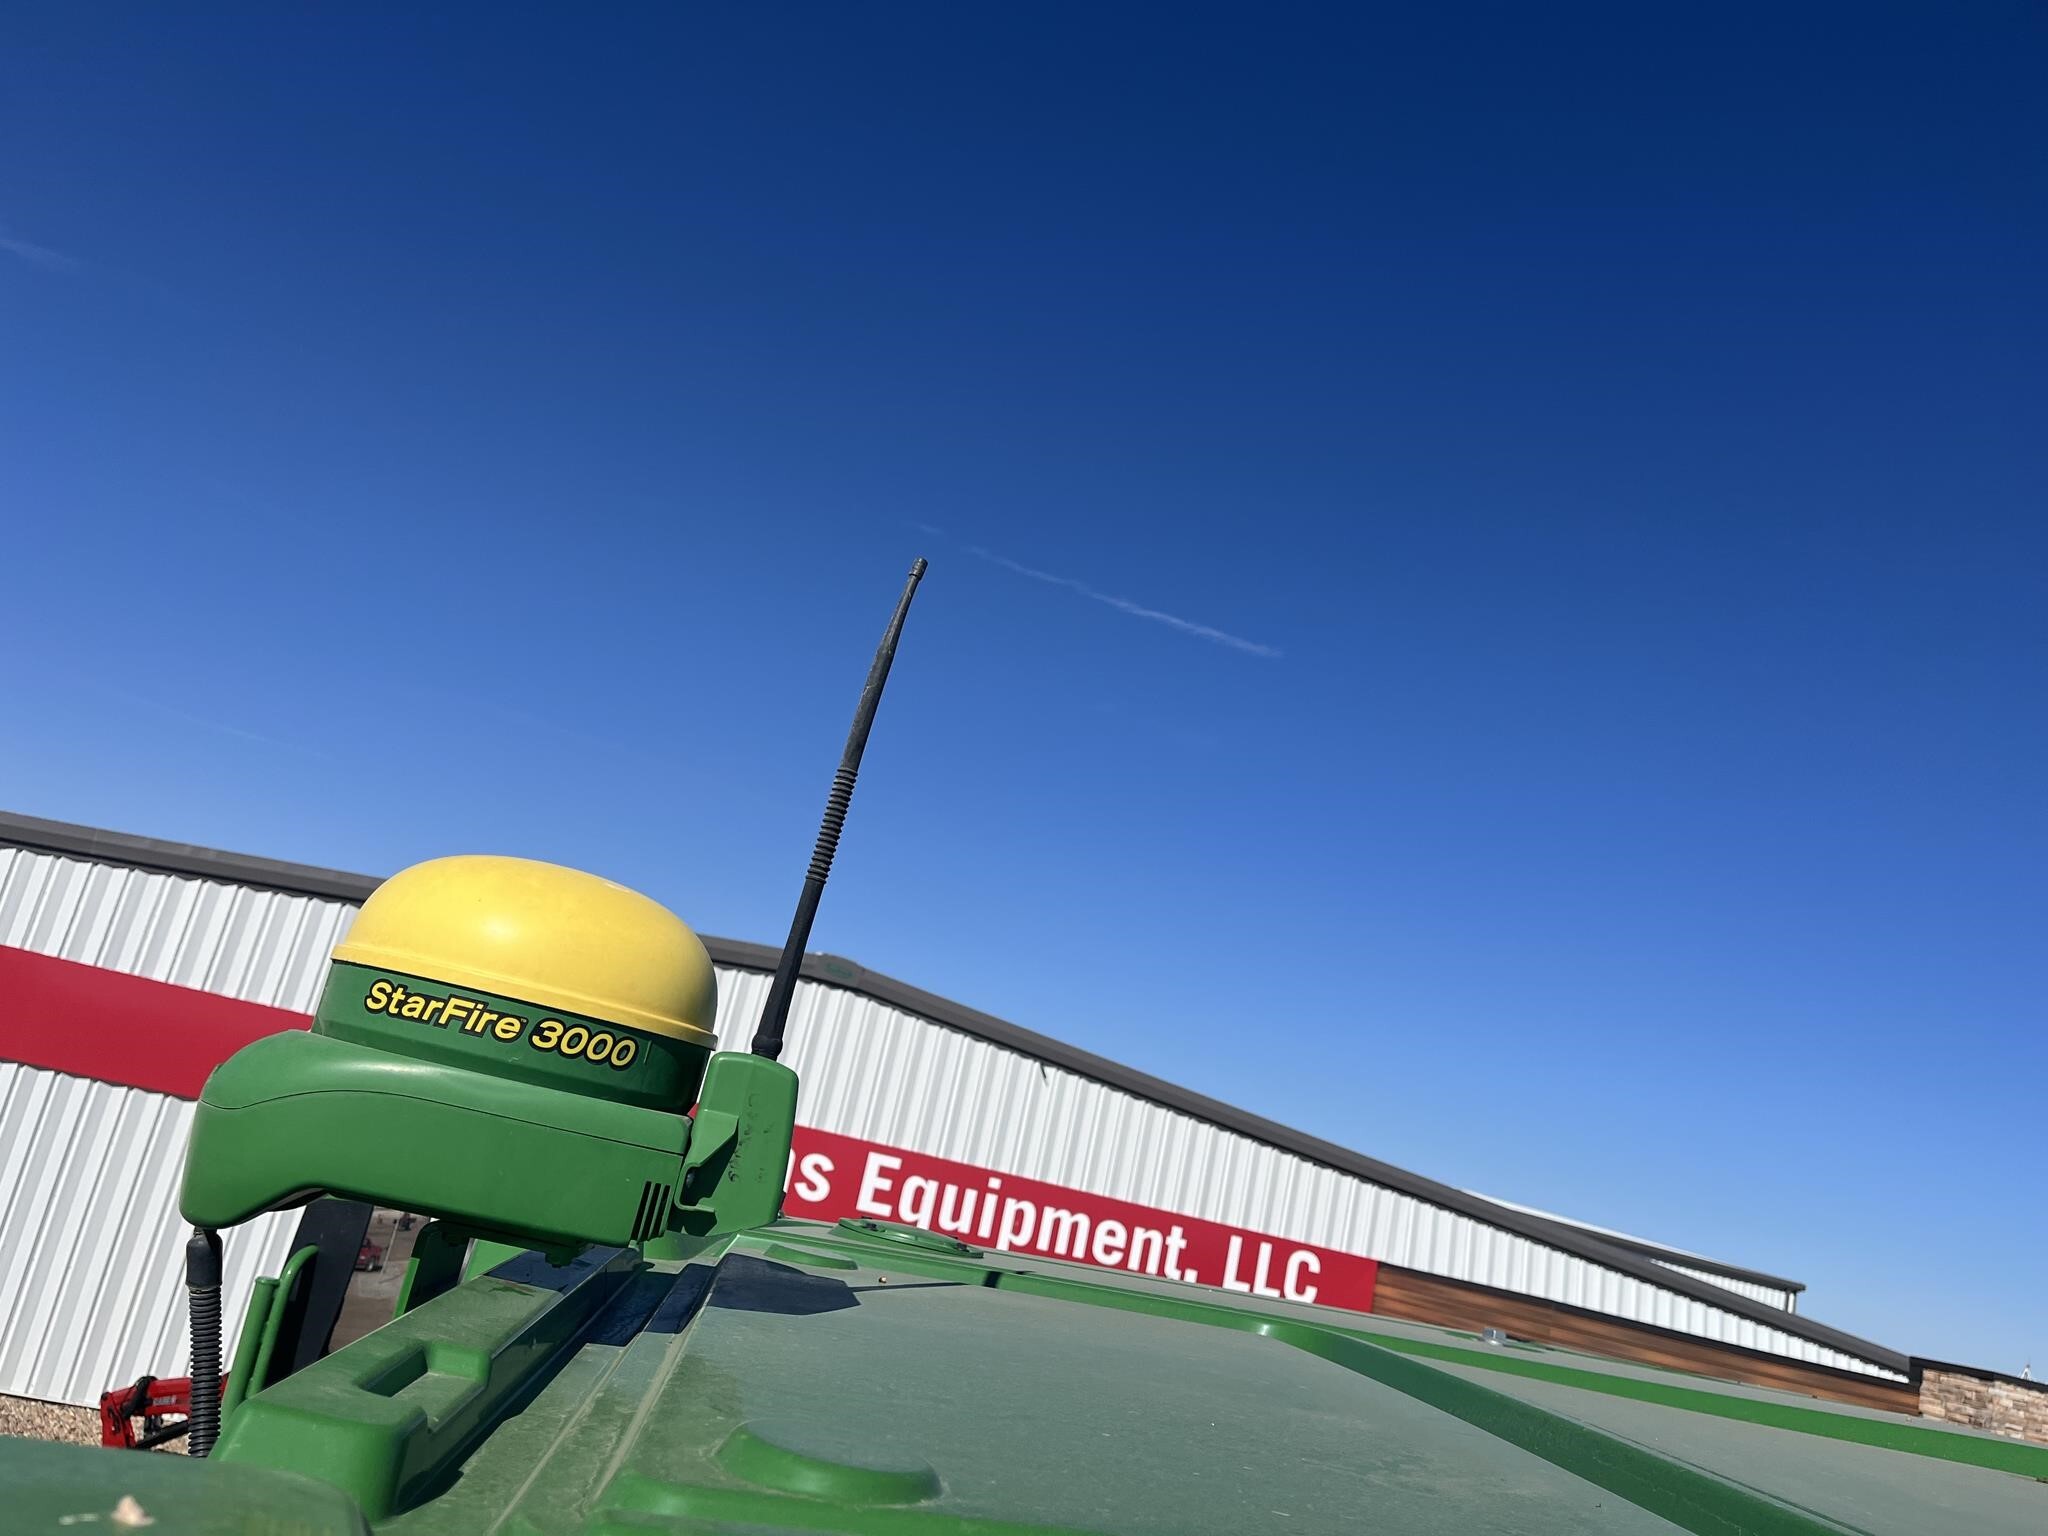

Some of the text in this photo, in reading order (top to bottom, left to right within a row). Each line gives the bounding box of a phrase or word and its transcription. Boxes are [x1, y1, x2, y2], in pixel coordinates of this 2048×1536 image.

[531, 1020, 637, 1068] 3000
[783, 1147, 835, 1203] s
[1222, 1234, 1322, 1304] LLC
